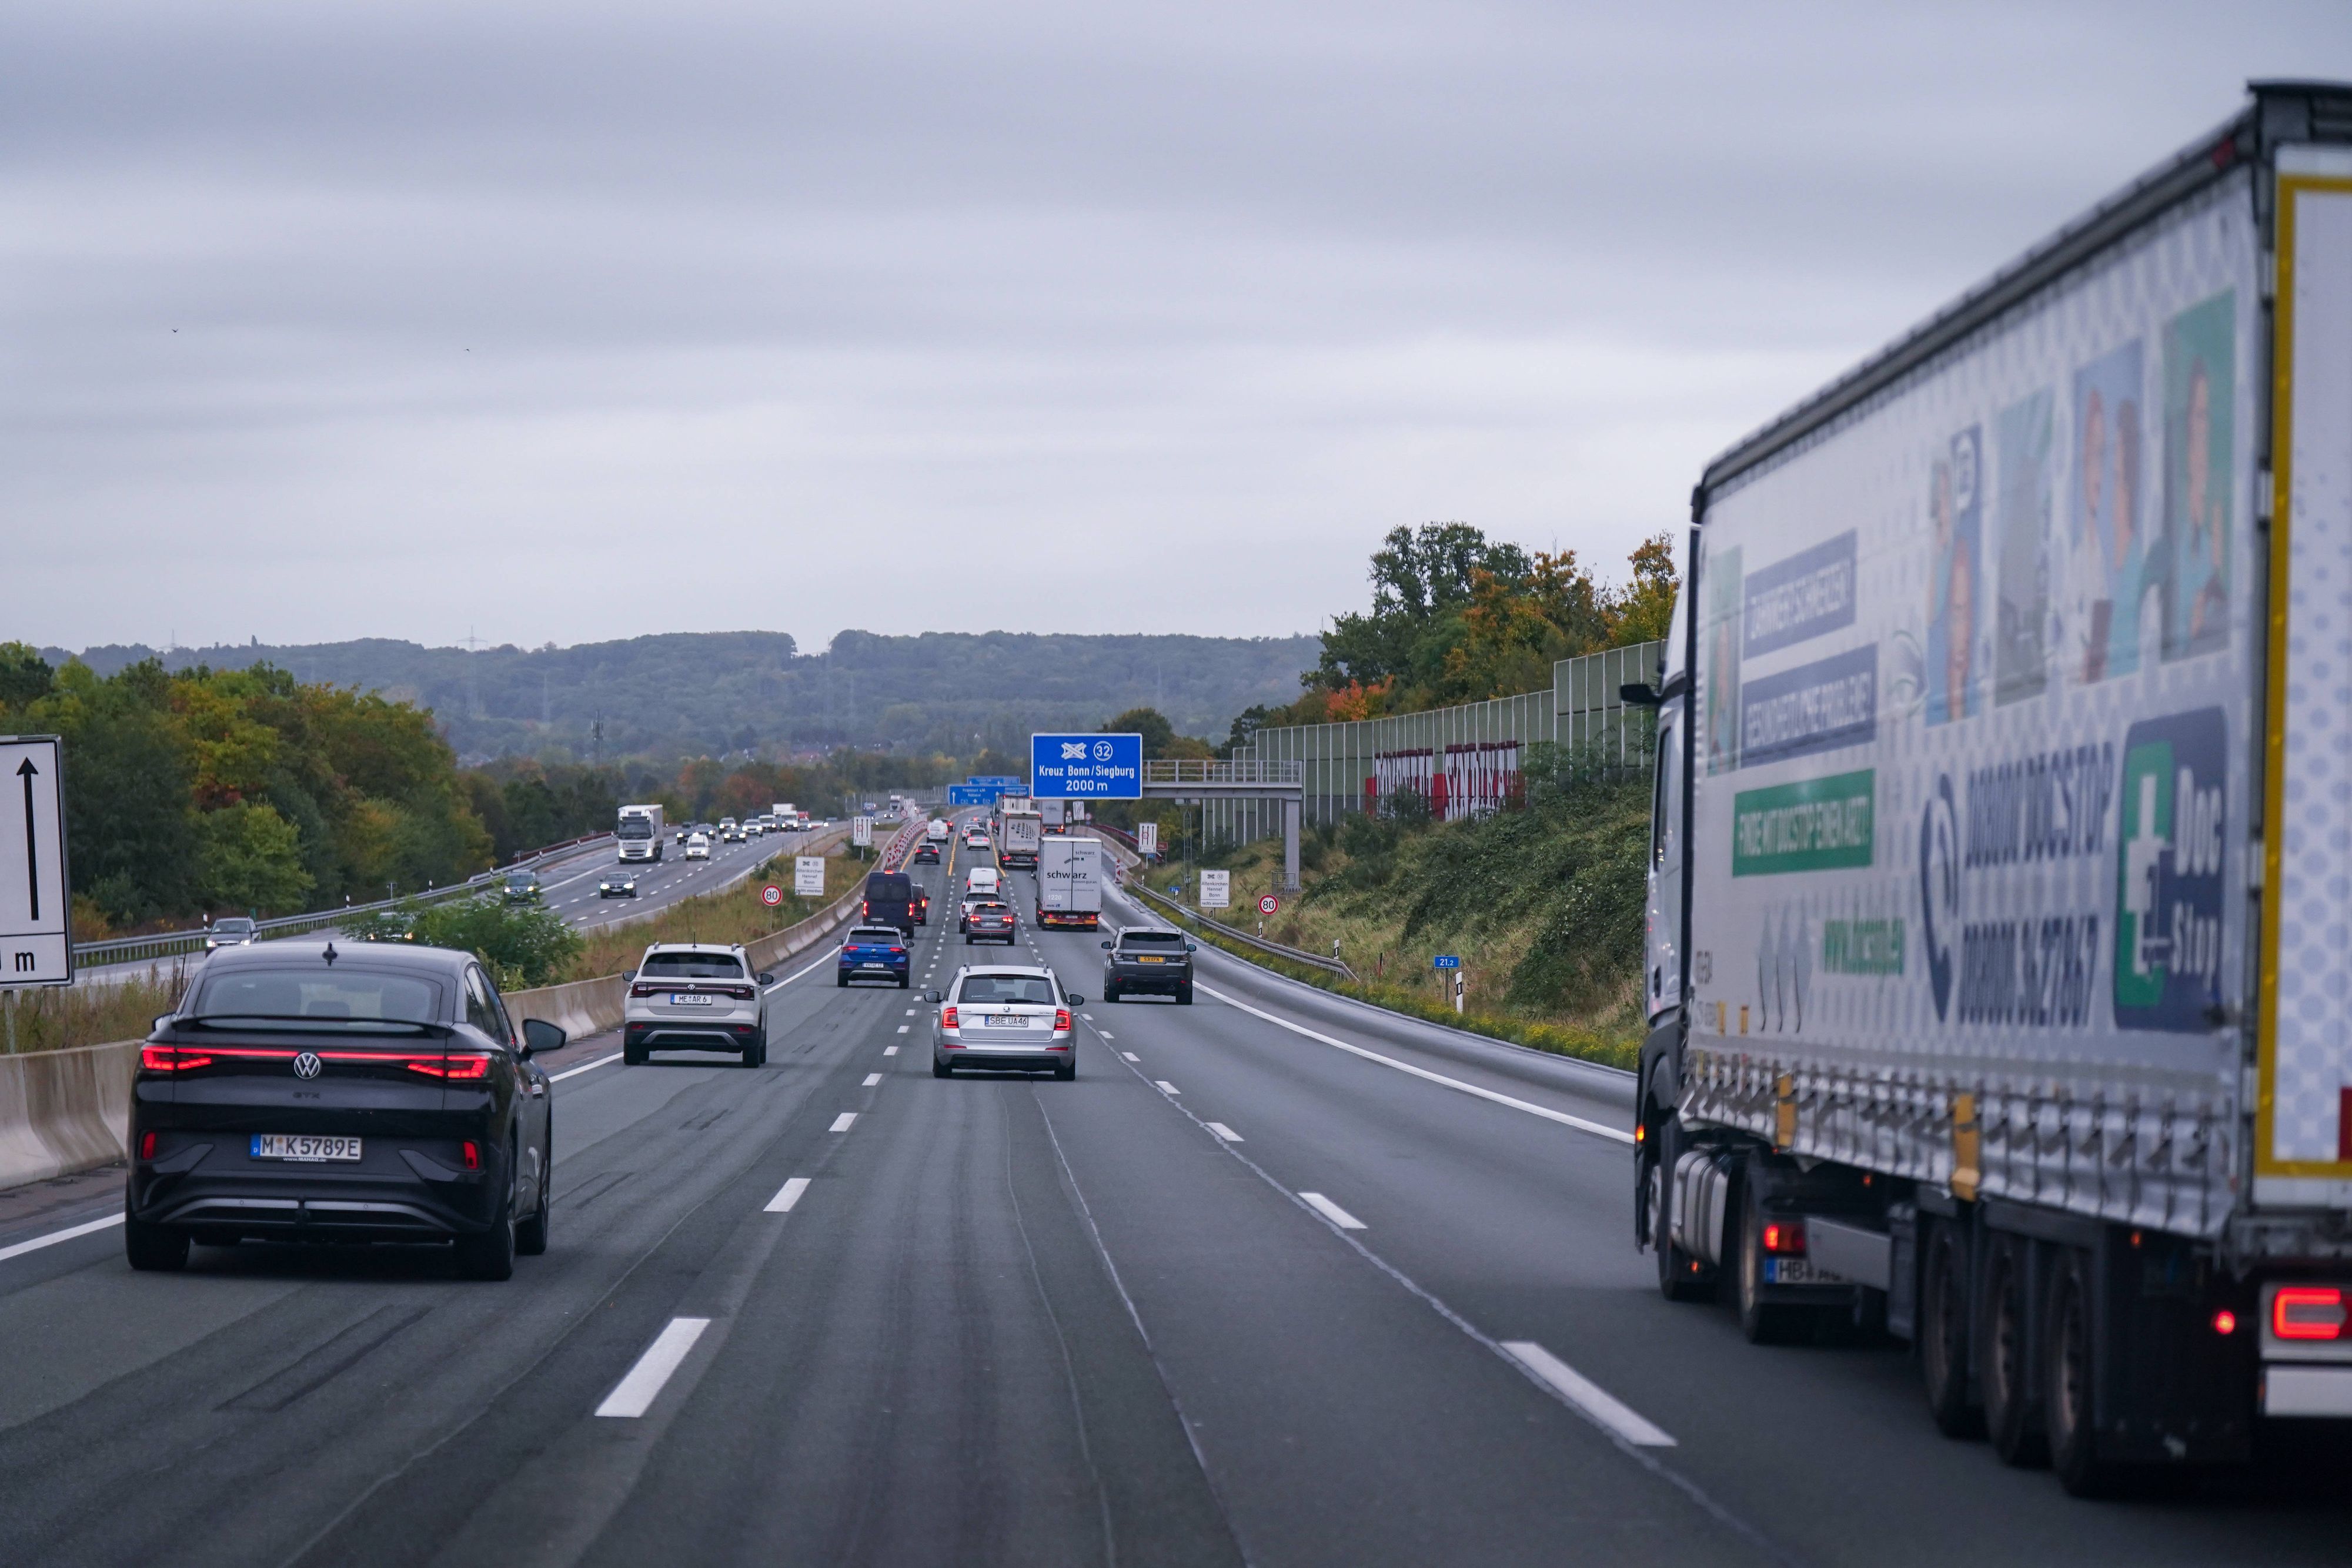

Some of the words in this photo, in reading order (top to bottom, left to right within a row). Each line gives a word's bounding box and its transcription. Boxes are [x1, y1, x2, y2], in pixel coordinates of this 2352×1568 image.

[1096, 745, 1110, 757] 32
[1039, 765, 1064, 776] Kreuz
[1066, 780, 1094, 791] 2000
[1097, 782, 1108, 791] m
[2176, 768, 2223, 876] Doc
[1047, 870, 1087, 880] schwarz
[766, 891, 777, 900] 80
[1262, 900, 1274, 910] 80
[2170, 901, 2219, 992] Stop
[15, 952, 35, 971] m
[990, 1017, 1006, 1025] SBE
[1008, 1017, 1027, 1025] UA46
[262, 1137, 273, 1154] M
